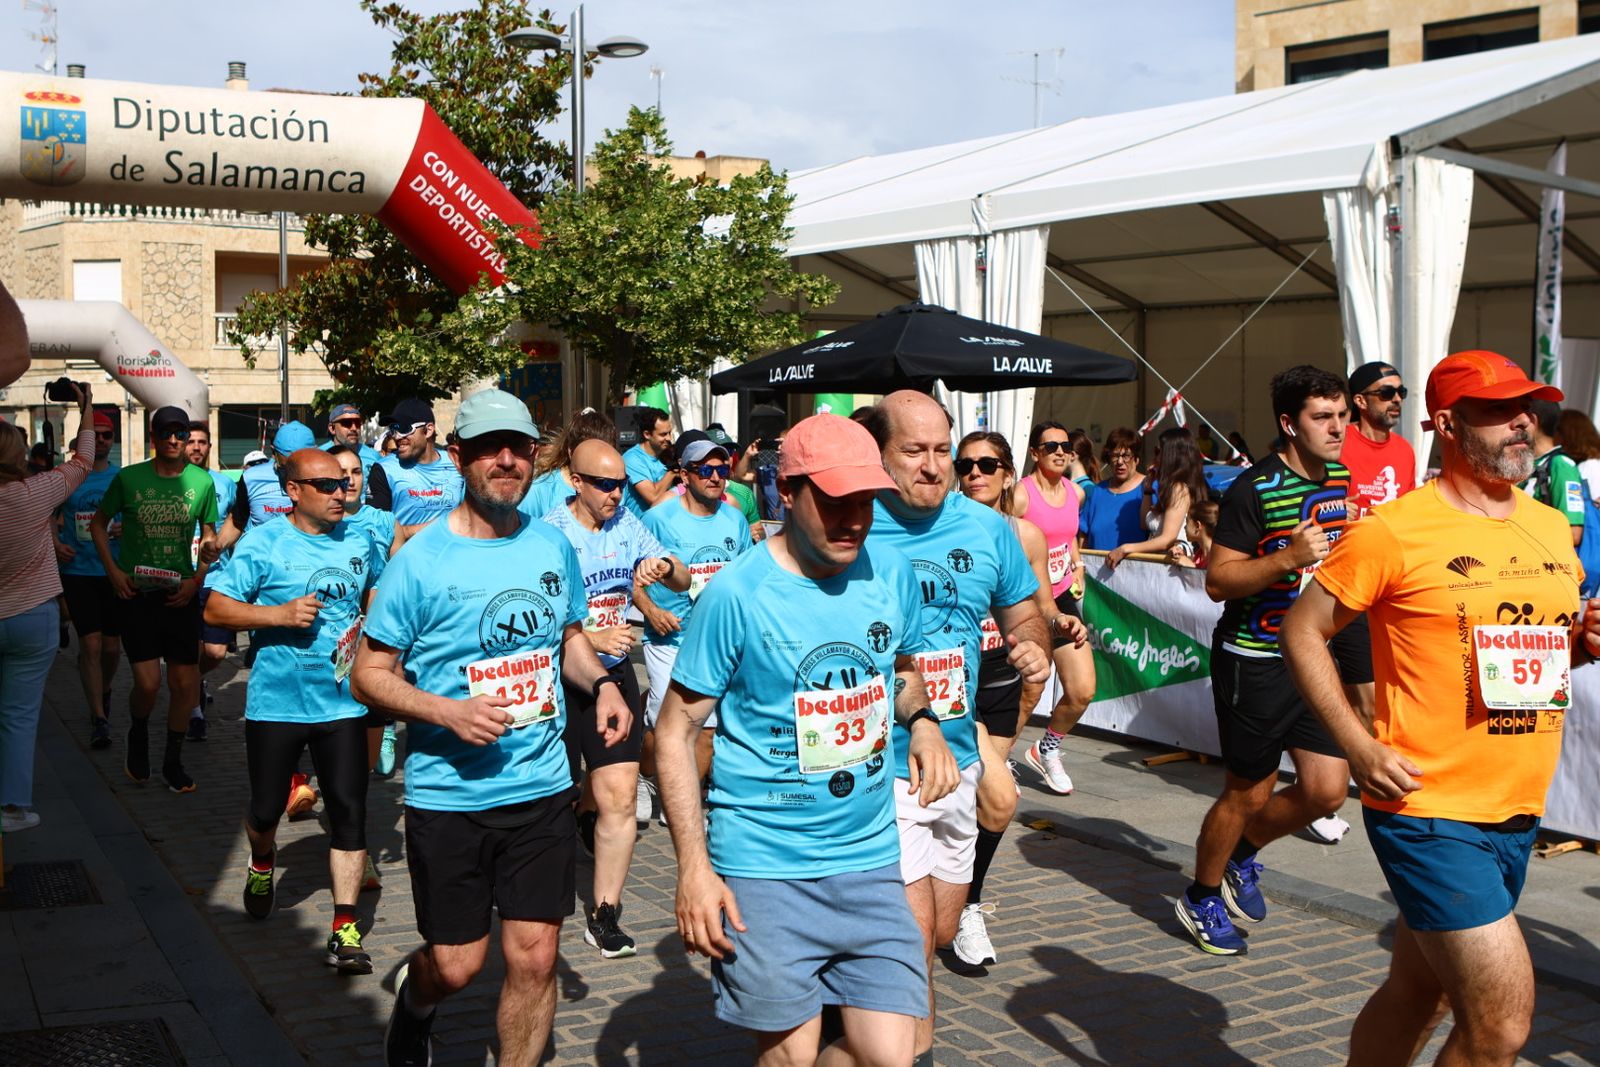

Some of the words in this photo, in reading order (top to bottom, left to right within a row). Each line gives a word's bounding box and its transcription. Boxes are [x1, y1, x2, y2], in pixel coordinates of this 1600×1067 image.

[112, 96, 330, 143] Diputación
[110, 154, 145, 183] de
[163, 150, 367, 195] Salamanca
[423, 151, 460, 189] CON
[409, 174, 508, 274] DEPORTISTAS
[30, 342, 72, 353] EBAN
[769, 368, 782, 383] LA
[783, 364, 815, 379] SALVE
[992, 356, 1012, 373] LA
[1012, 357, 1053, 374] SALVE
[588, 596, 626, 609] edunia
[496, 609, 539, 643] XII
[596, 610, 619, 628] 245
[1456, 602, 1469, 644] ASPACE
[1100, 627, 1139, 660] Corte
[1138, 627, 1200, 676] Inglés
[1476, 629, 1566, 651] bedunia
[468, 653, 550, 684] bedunia
[1512, 659, 1543, 685] 59
[496, 680, 539, 705] 132
[1463, 652, 1475, 718] VILLAMAYOR
[797, 684, 885, 717] bedunia
[834, 718, 866, 746] 33
[1488, 716, 1536, 728] KONE
